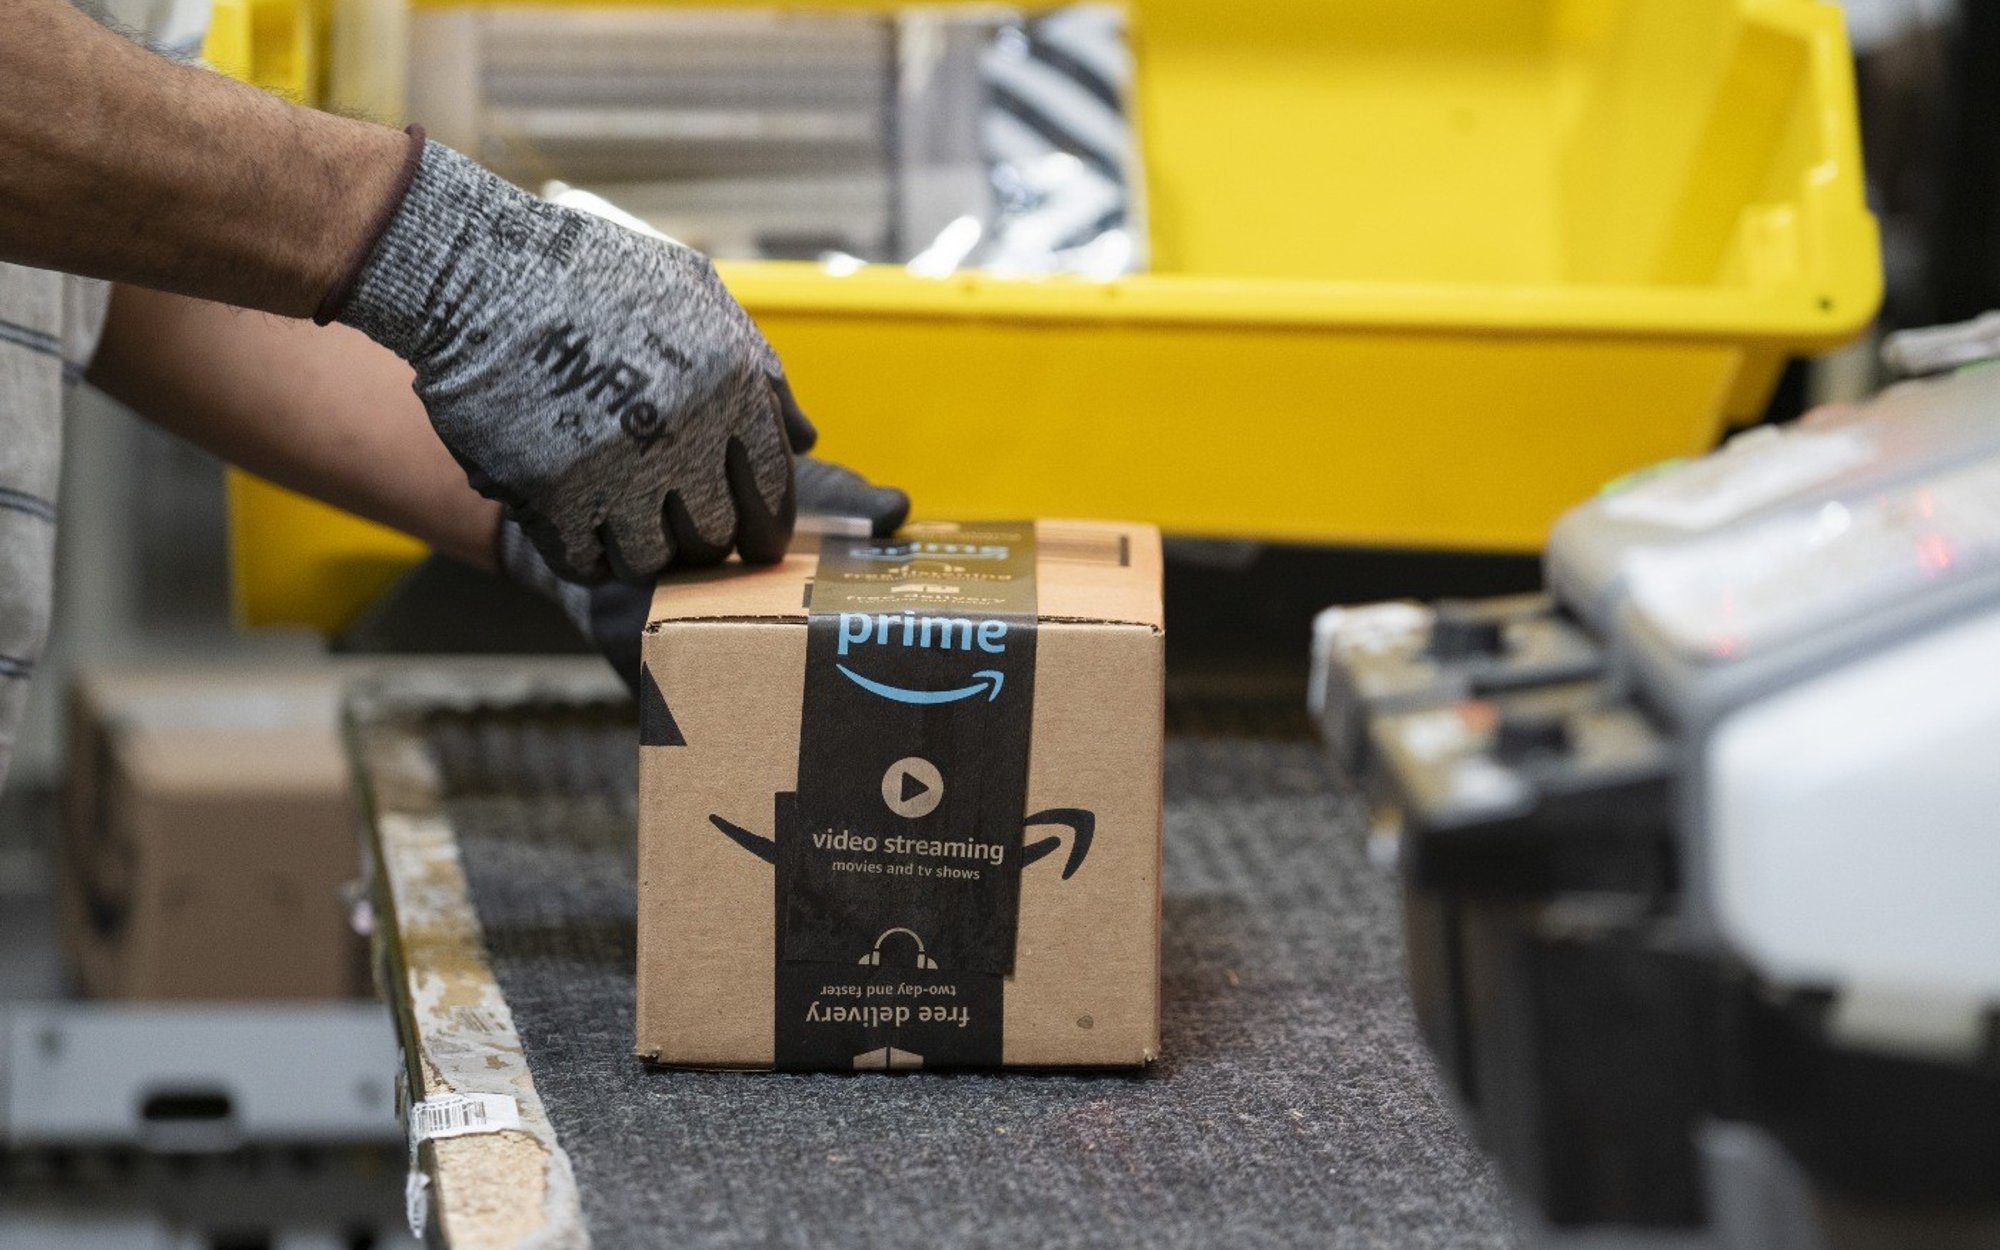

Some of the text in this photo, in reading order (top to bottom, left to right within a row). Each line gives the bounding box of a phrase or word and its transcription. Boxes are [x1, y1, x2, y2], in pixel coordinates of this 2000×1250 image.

[837, 610, 1008, 655] prime
[812, 828, 1005, 865] video streaming
[832, 860, 980, 880] movies and tv shows
[820, 982, 957, 998] two-day and faster
[806, 1001, 970, 1028] free delivery
